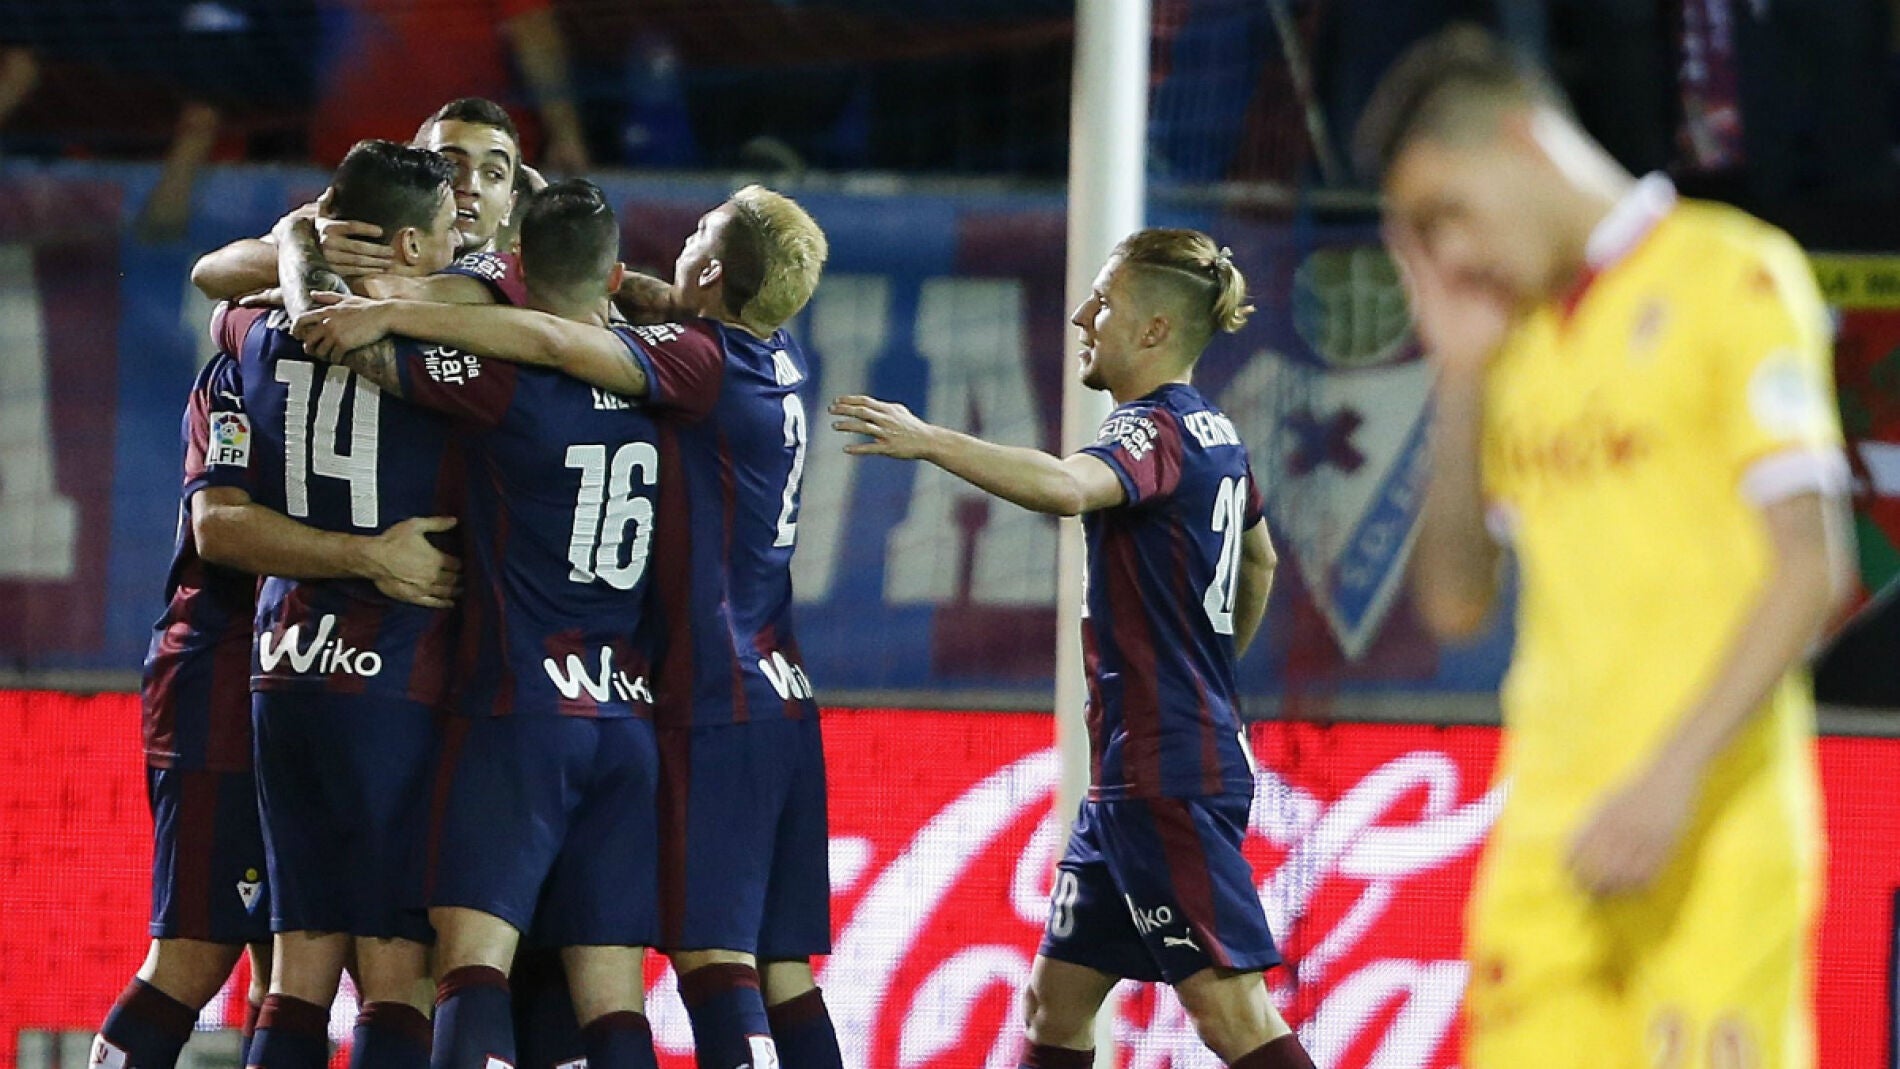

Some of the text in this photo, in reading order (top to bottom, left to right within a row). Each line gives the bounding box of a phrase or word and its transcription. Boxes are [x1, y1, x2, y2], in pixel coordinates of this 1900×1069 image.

[275, 358, 381, 529] 14
[564, 441, 658, 590] 16
[259, 613, 382, 677] Wiko
